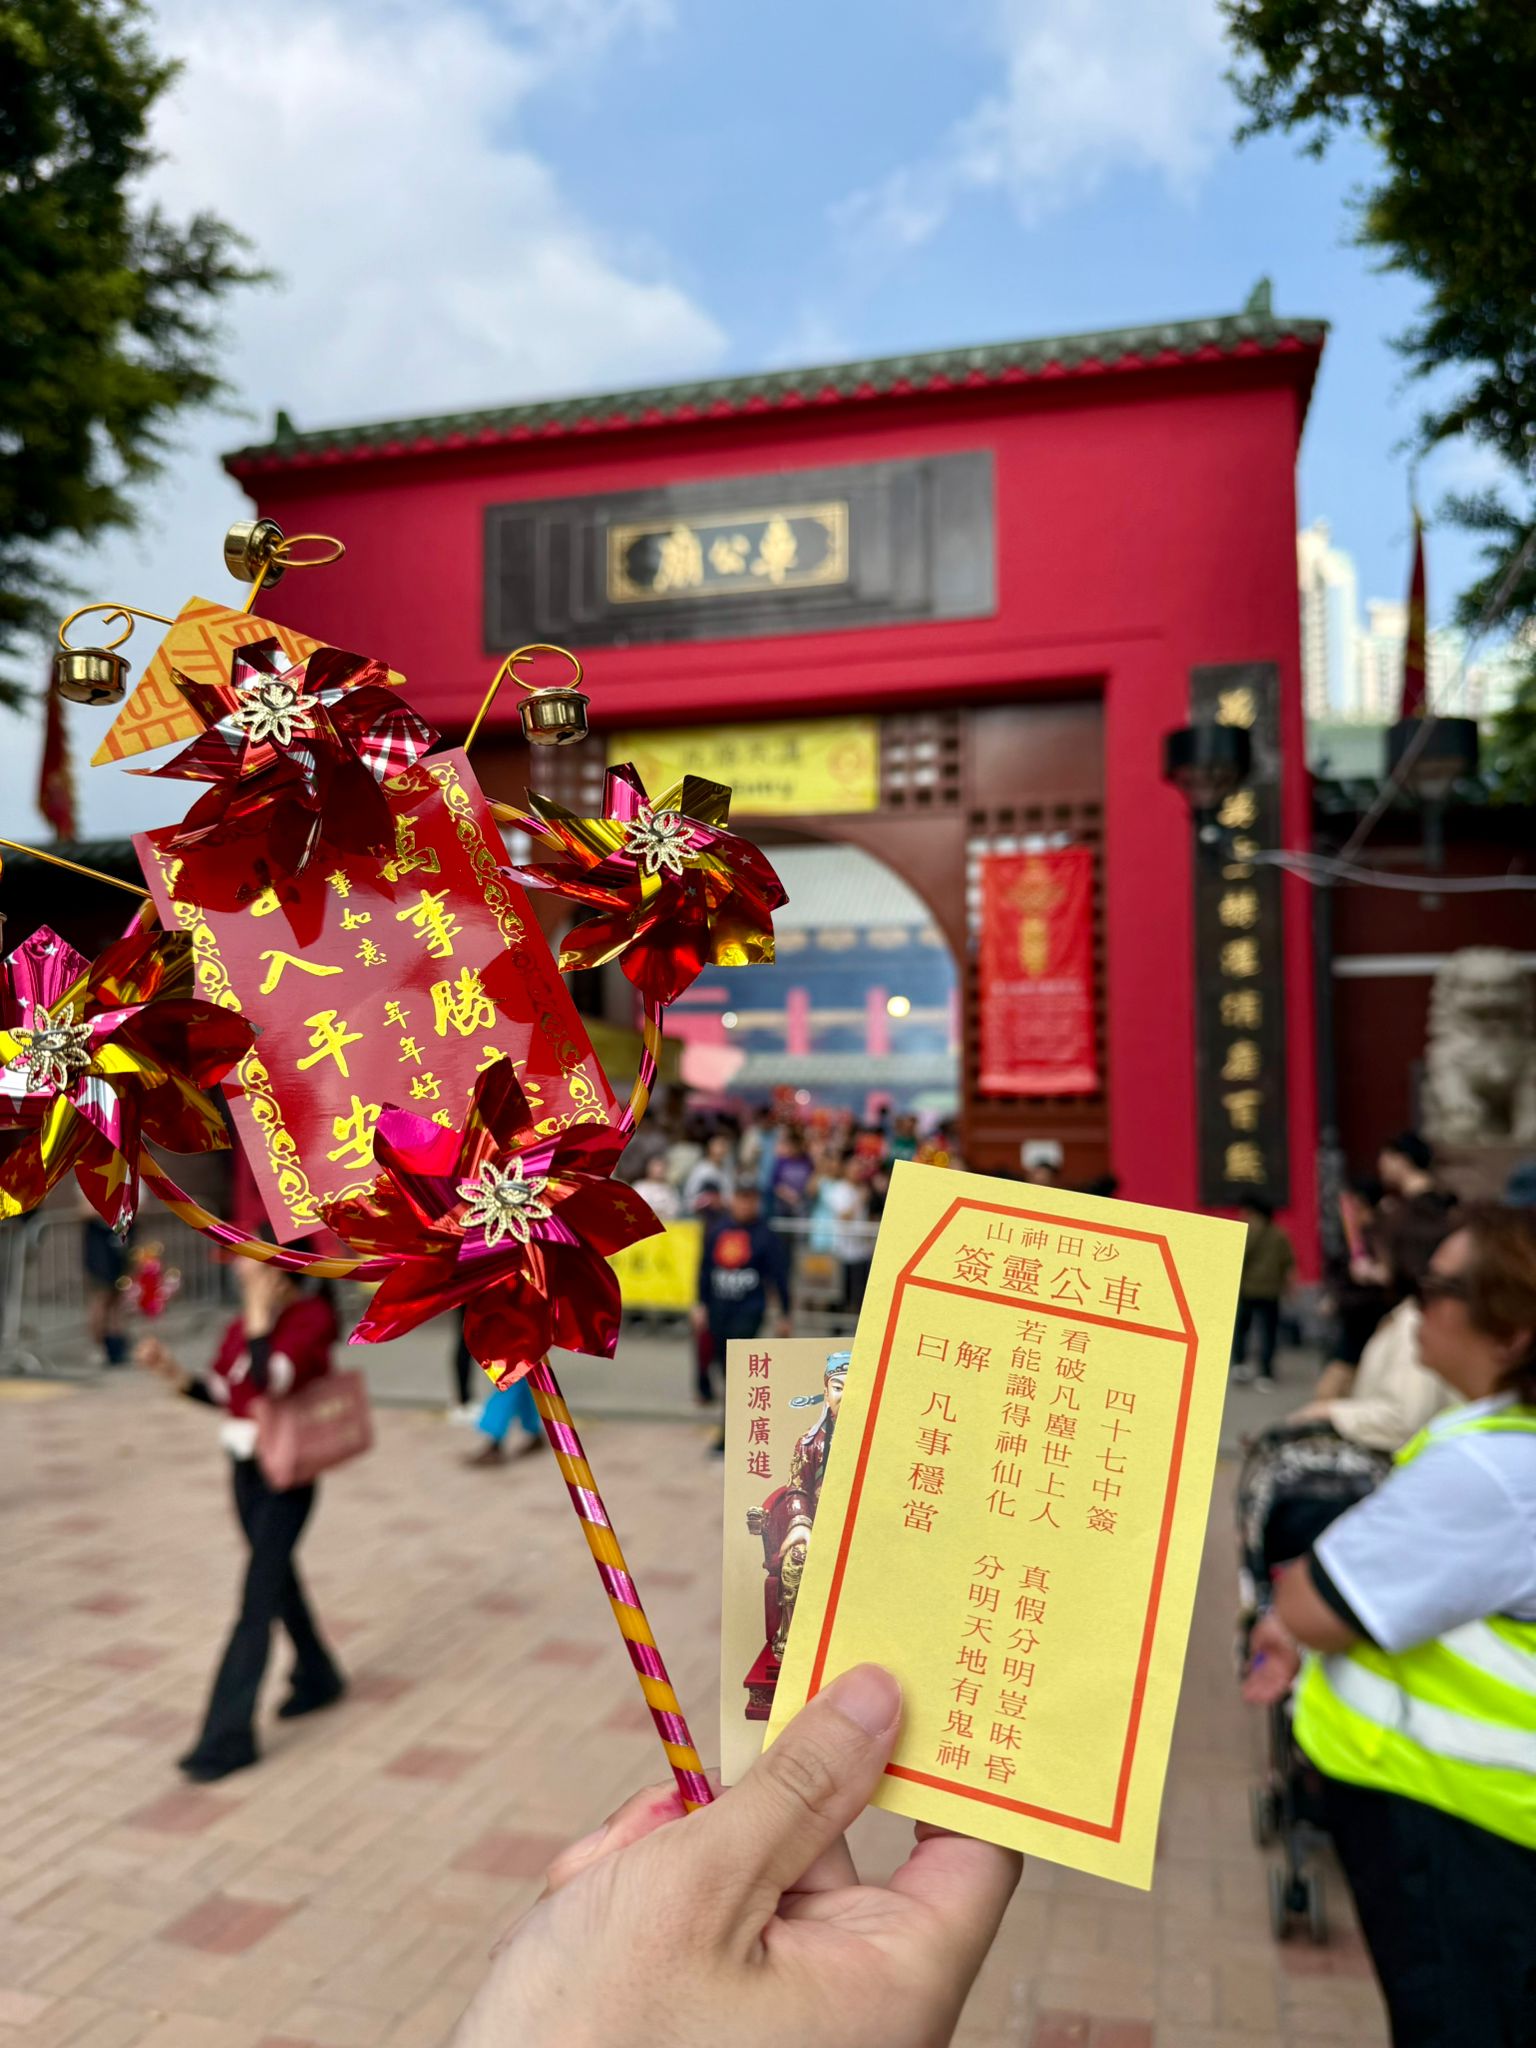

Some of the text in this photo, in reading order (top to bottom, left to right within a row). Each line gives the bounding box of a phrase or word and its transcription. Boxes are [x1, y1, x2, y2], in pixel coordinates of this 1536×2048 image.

[324, 869, 387, 966] 事如意
[376, 813, 544, 1112] 萬事勝
[952, 1244, 1143, 1315] 車公靈簽
[986, 1222, 1120, 1263] 沙田神山
[747, 1352, 773, 1479] 財源廣進
[916, 1334, 992, 1372] 解曰
[902, 1392, 957, 1533] 凡事穩當
[1086, 1388, 1136, 1535] 四十七中簽
[936, 1319, 1047, 1771] 若能識得神仙化 分明天地有鬼神
[984, 1329, 1091, 1784] 看破凡塵世上人 真假分明豈昧昏
